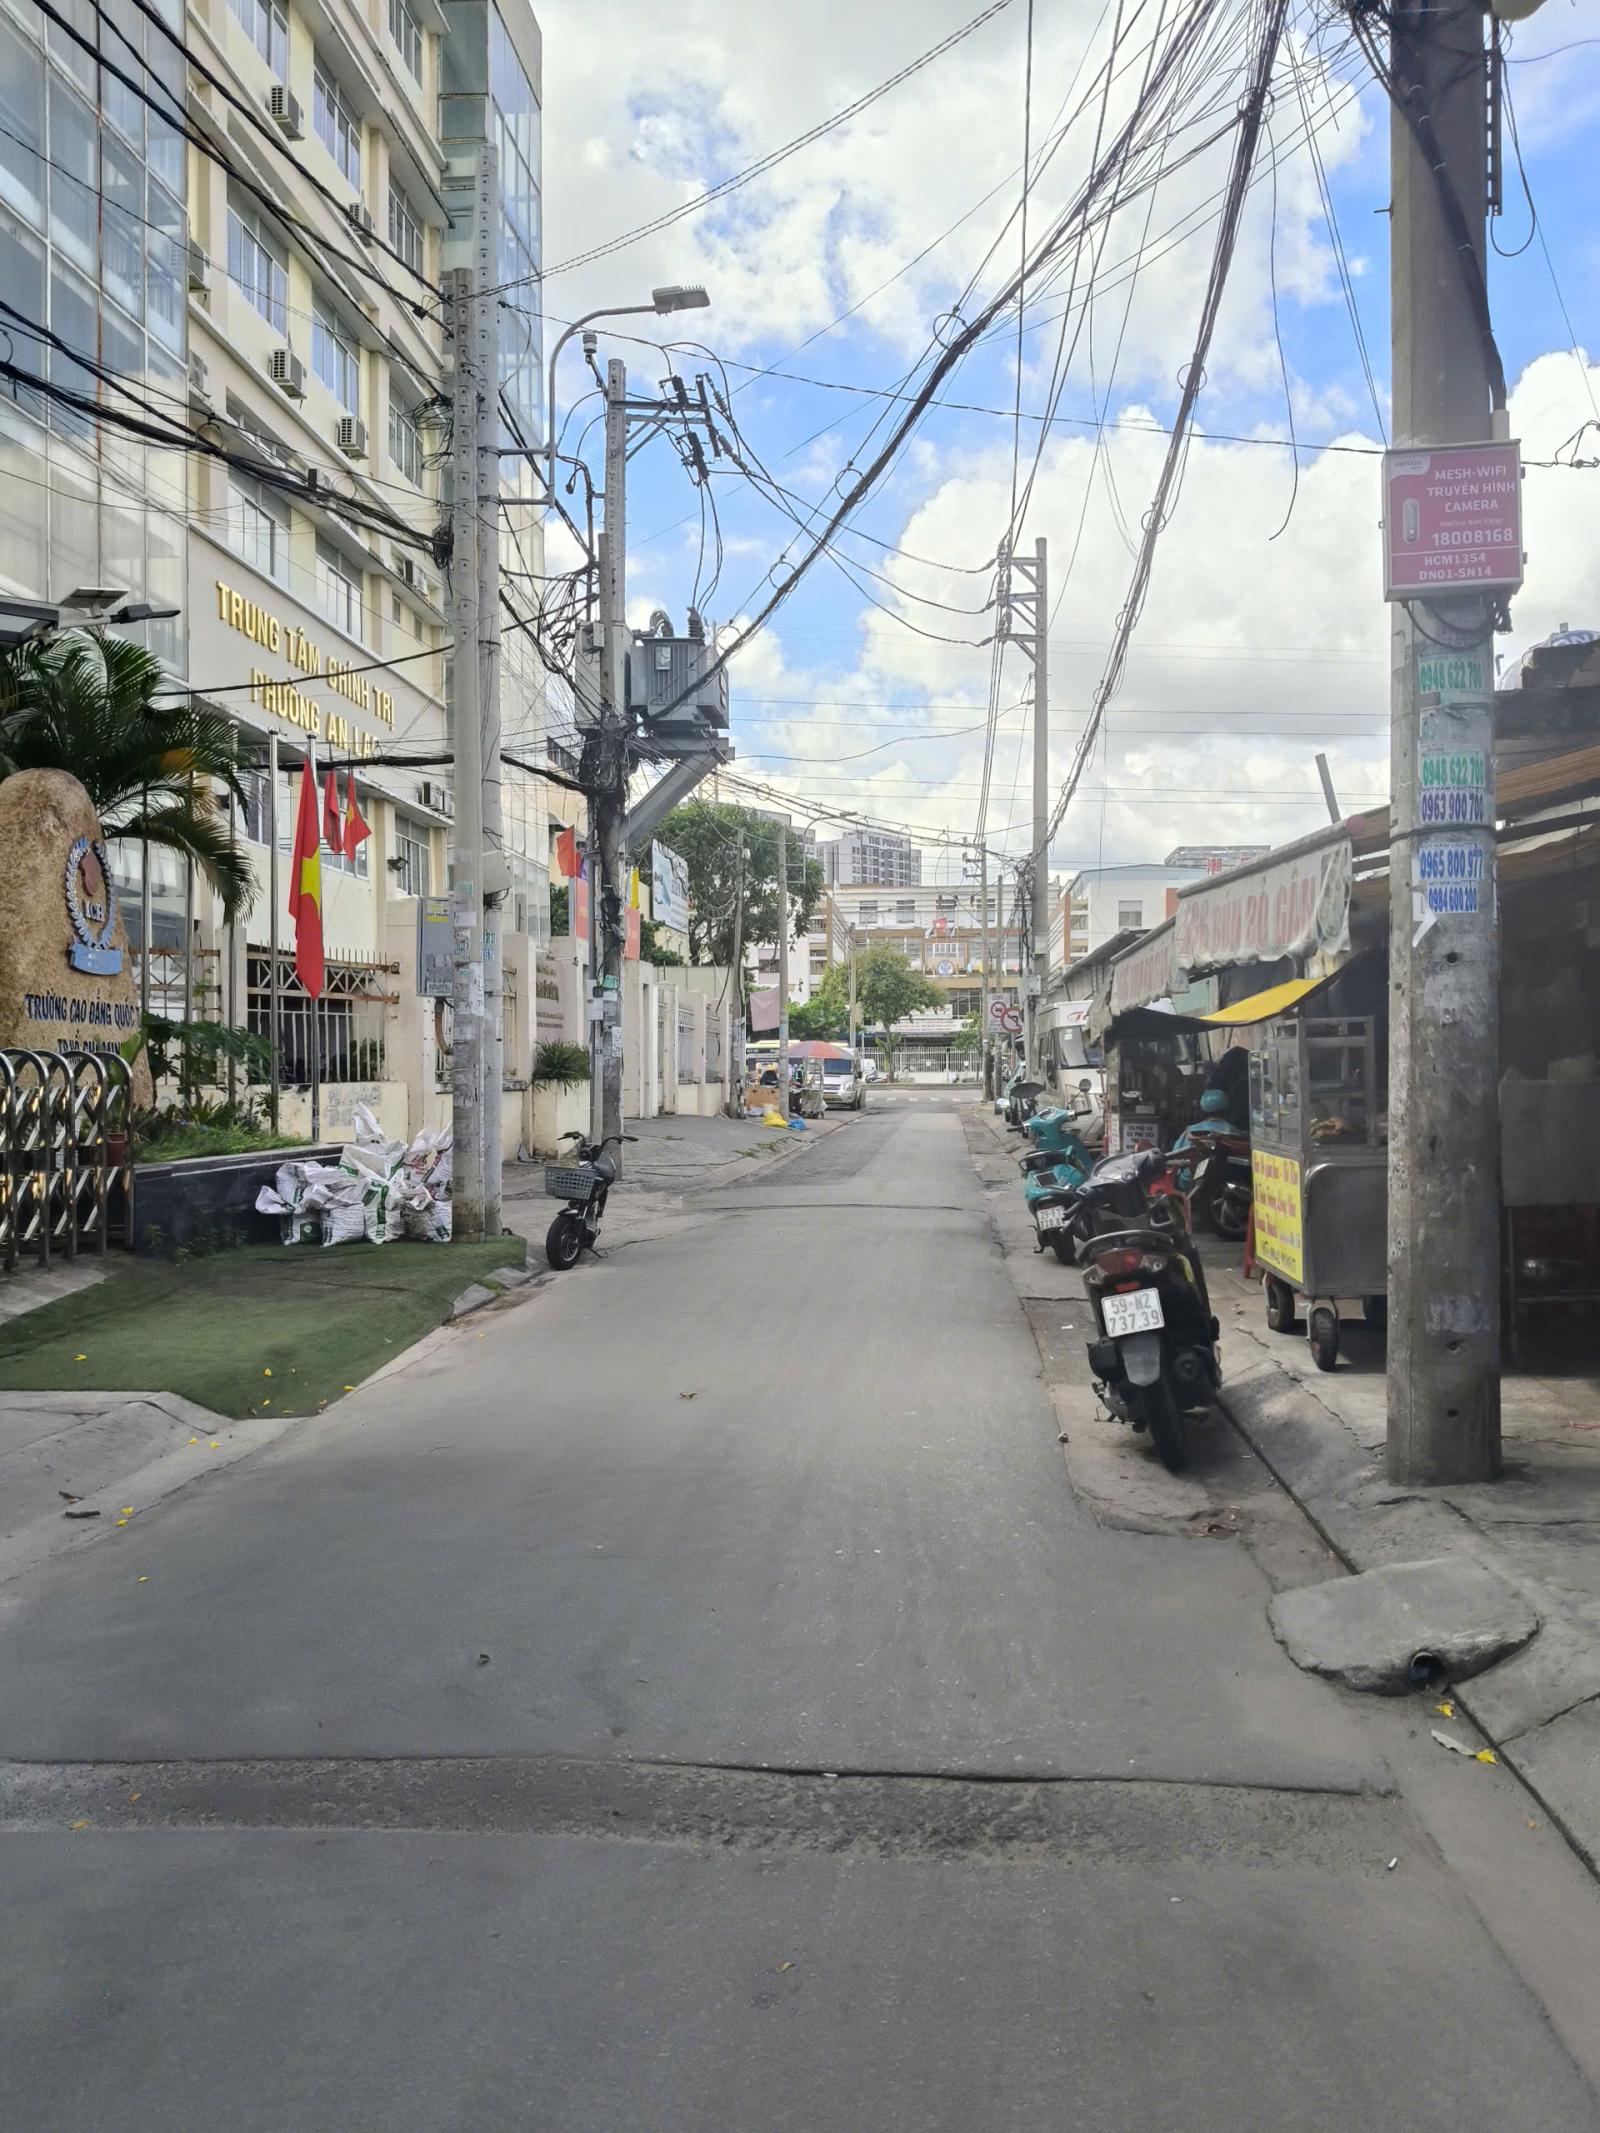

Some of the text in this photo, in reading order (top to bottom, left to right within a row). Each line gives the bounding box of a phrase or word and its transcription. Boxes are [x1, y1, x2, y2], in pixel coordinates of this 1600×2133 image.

[1435, 465, 1507, 481] MESH-WIFI
[1444, 499, 1499, 513] CAMERA
[1432, 528, 1513, 547] 18008168
[1424, 552, 1486, 567] HCM1354
[1418, 566, 1492, 581] DN01-SN14
[216, 580, 280, 653] TRUNG
[284, 626, 321, 676] TÂM
[372, 686, 395, 732] TRỊ
[326, 712, 348, 751] AN
[24, 987, 67, 1022] TRƯỜNG
[69, 998, 87, 1024] CAO
[88, 988, 112, 1027] ĐẲNG
[1109, 1309, 1160, 1334] 737.39
